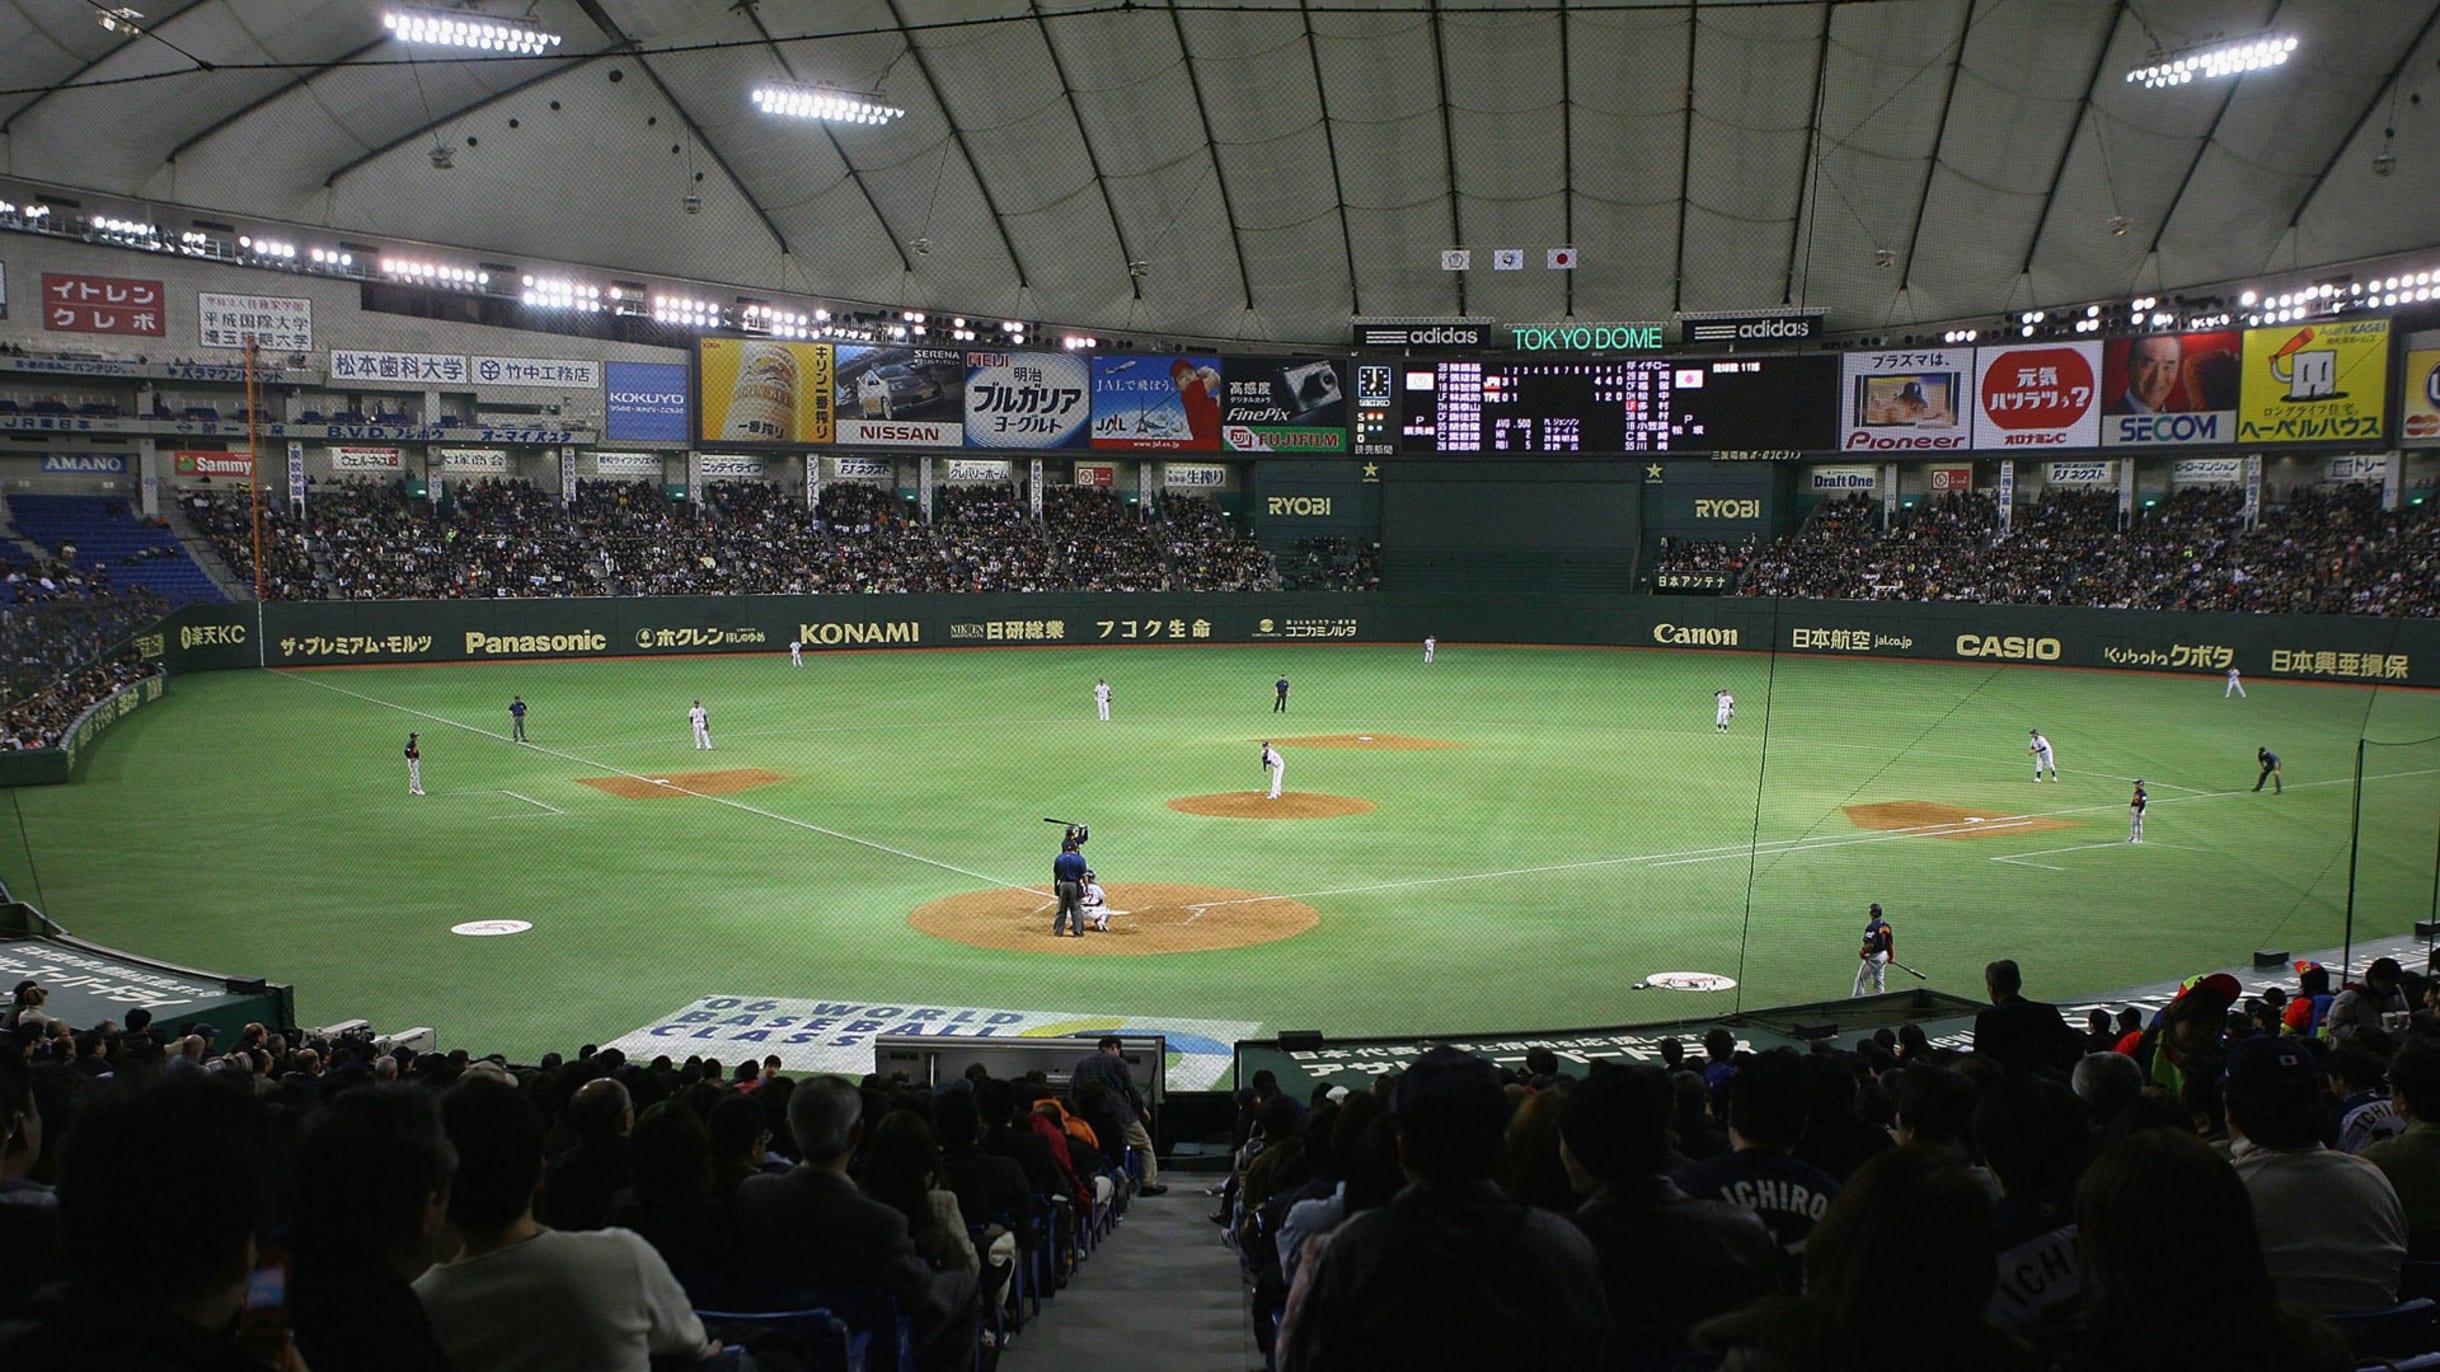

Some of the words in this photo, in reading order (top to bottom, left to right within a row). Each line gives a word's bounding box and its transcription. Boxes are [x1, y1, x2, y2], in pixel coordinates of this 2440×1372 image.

[205, 311, 308, 331] 平成国際大学
[1739, 319, 1809, 338] adidas
[1410, 328, 1478, 344] adidas
[1512, 328, 1590, 350] TOKYO
[1596, 327, 1663, 349] DOME
[914, 349, 960, 360] SERENA
[336, 353, 464, 380] 松本歯科大学
[506, 363, 590, 382] 竹中工務店
[1014, 367, 1042, 382] 明治
[2017, 367, 2058, 387] 元気
[816, 346, 828, 439] キリン一番搾り
[973, 382, 1082, 414] ブルガリア
[1229, 382, 1271, 395] 高感度
[610, 393, 684, 404] KOKUYO
[994, 415, 1063, 433] ヨーグルト
[1226, 408, 1291, 421] FinePix
[1357, 412, 1365, 422] S
[1684, 415, 1693, 424] P
[327, 426, 388, 439] B.V.D.
[738, 420, 784, 439] 一番搾り
[860, 425, 939, 441] NISSAN
[1096, 414, 1127, 436] JAL
[1357, 423, 1365, 433] B
[2120, 414, 2217, 442] SECOM
[2240, 417, 2379, 439] ヘーベルハウス
[1259, 433, 1339, 447] FUJIFILM
[1846, 431, 1965, 449] Pioneer
[2005, 433, 2067, 445] オロナミンC
[45, 454, 122, 471] AMANO
[196, 457, 252, 475] Sammy
[1187, 470, 1225, 485] 生搾り
[1814, 475, 1846, 488] Draft
[1848, 475, 1874, 487] One
[1267, 497, 1331, 516] RYOBI
[1695, 499, 1760, 519] RYOBI
[1658, 575, 1726, 588] 日本アンテナ
[656, 628, 724, 647] ホクレン
[800, 622, 919, 645] KONAMI
[987, 620, 1065, 640] 日研総業
[1096, 618, 1212, 639] フコク生命
[1286, 626, 1357, 637] コニカミノルタ
[1653, 623, 1738, 646] Canon
[280, 634, 432, 657] ザ・プレミアム・モルツ
[465, 629, 606, 654] Panasonic
[1792, 628, 1871, 650] 日本航空
[1874, 634, 1912, 649] jal.co.jp
[1956, 634, 2061, 661] CASIO
[2104, 646, 2168, 666] Kubota
[2170, 644, 2234, 669] クボタ
[2271, 649, 2409, 679] 日本興亜損保
[675, 1010, 998, 1038] BASEBALL
[812, 1003, 1024, 1026] WORLD
[649, 1024, 870, 1048] CLASS
[2354, 1100, 2393, 1132] ICHI
[1720, 1180, 1828, 1222] ICHIRO
